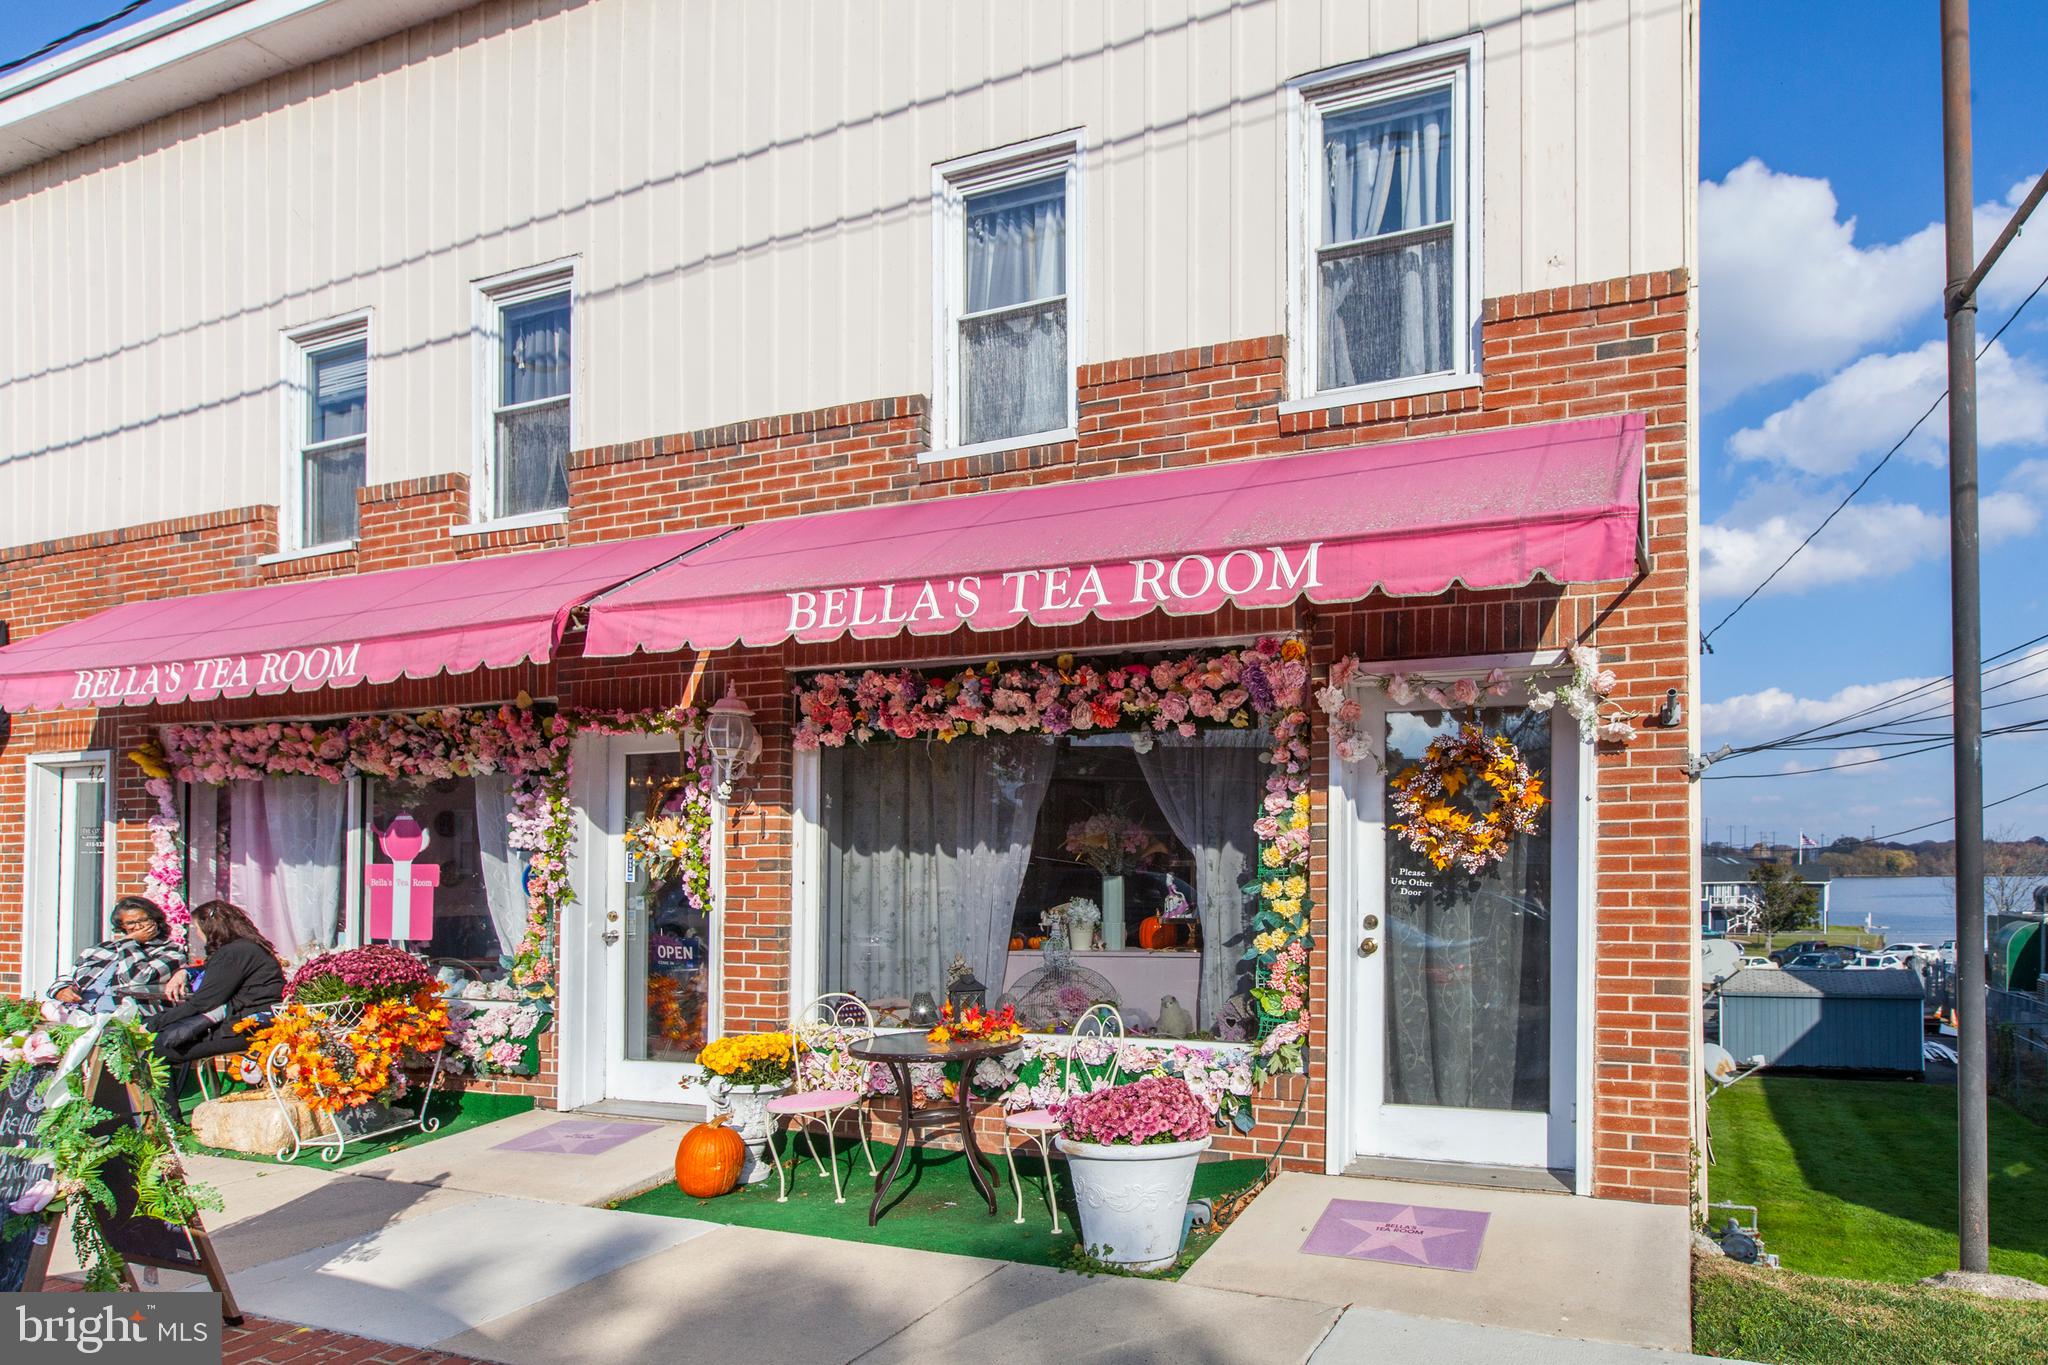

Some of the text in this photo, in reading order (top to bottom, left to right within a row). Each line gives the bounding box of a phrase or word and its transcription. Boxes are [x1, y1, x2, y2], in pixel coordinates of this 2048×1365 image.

[785, 541, 1324, 632] BELLA'S TEA ROOM
[72, 643, 361, 699] BELLA'S TEA ROOM
[1399, 868, 1426, 876] Please
[370, 878, 433, 887] Bella's Tea Room
[1391, 877, 1433, 887] Use Other
[1400, 887, 1422, 896] Door
[657, 945, 693, 960] OPEN
